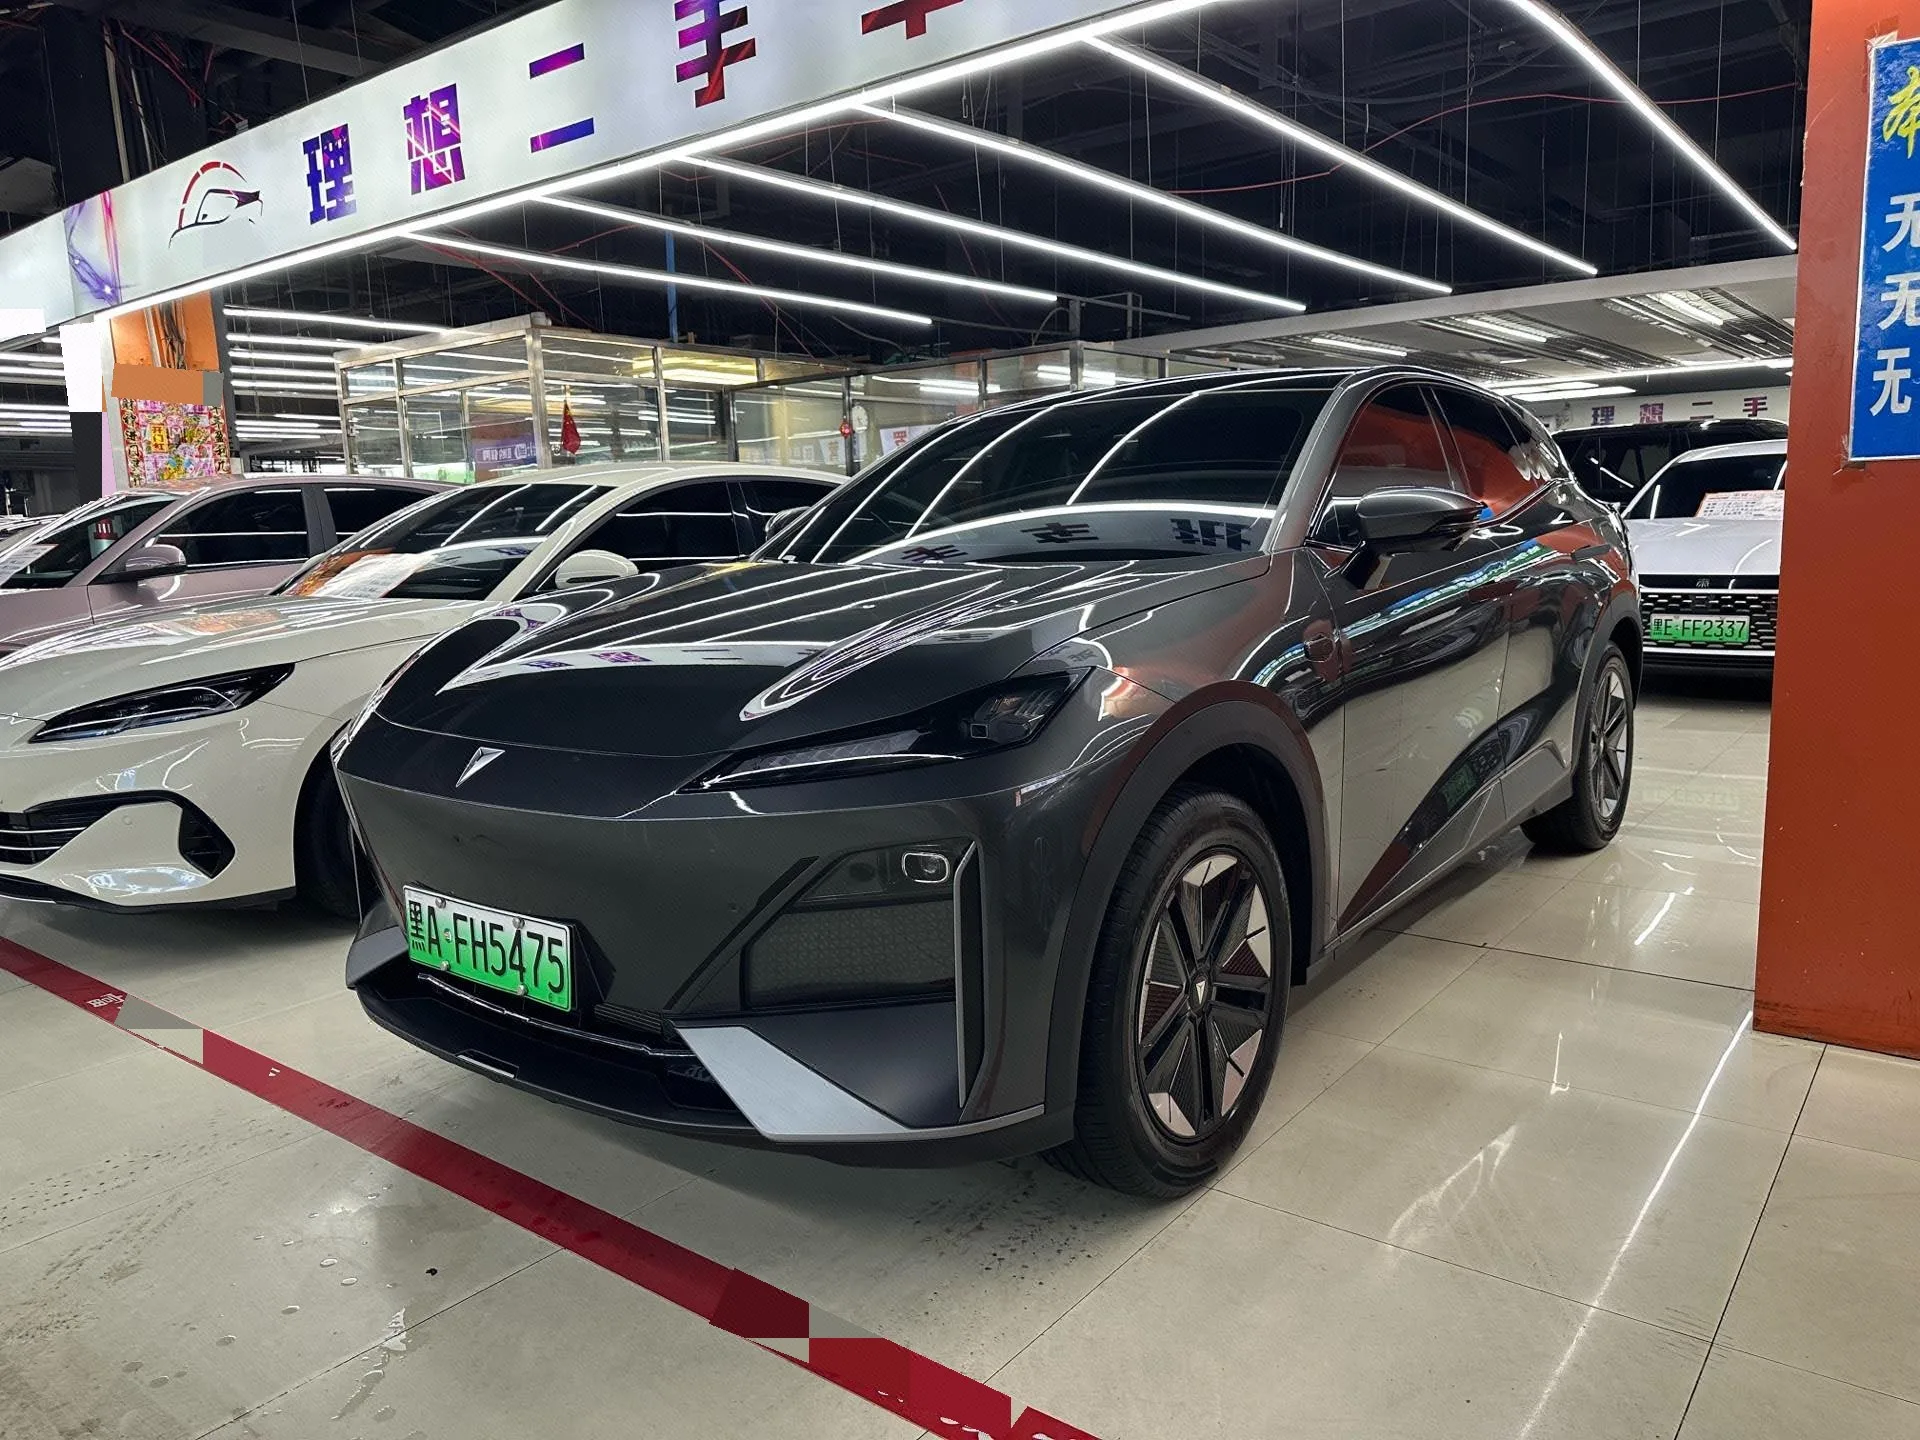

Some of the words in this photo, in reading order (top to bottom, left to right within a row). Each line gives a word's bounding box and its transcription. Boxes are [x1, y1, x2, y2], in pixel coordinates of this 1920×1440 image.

[303, 0, 965, 225] 理想二手
[1870, 348, 1912, 417] 无
[152, 426, 165, 450] 开门红
